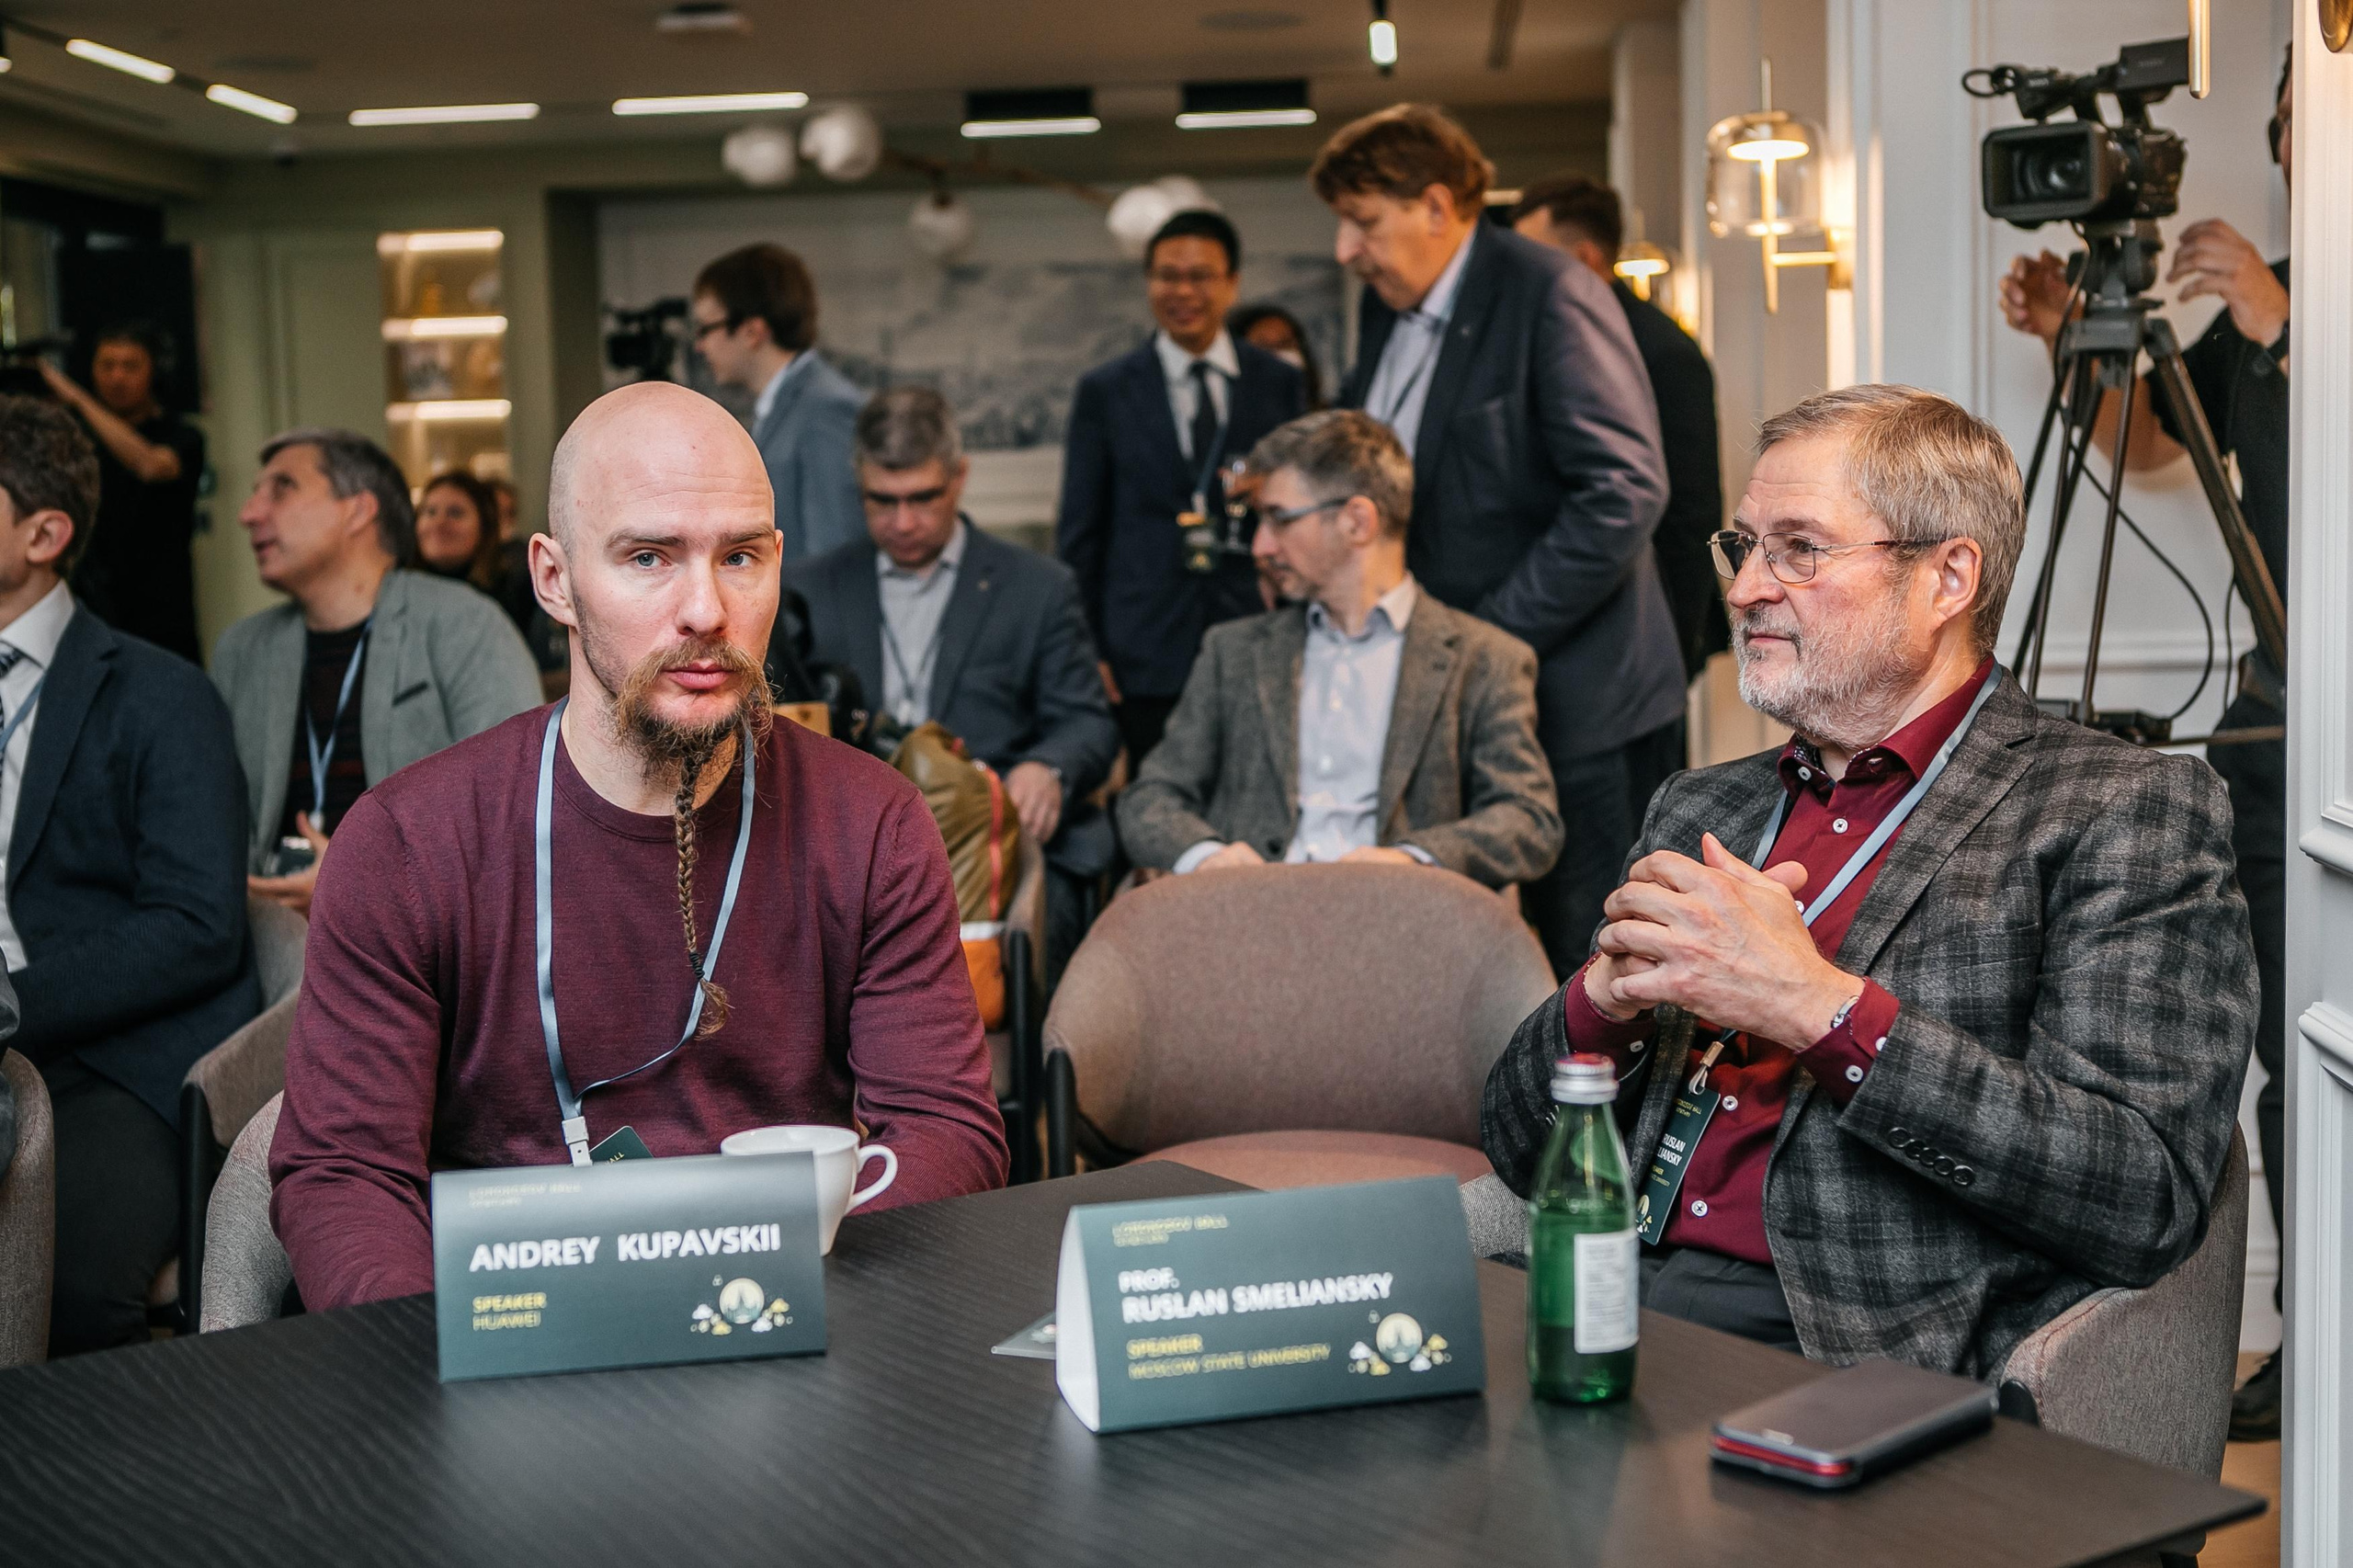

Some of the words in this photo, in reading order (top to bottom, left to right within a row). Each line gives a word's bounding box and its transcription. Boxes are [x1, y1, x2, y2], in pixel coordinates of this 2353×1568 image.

[1662, 1133, 1686, 1153] RUSLAN
[469, 1236, 601, 1272] ANDREY
[618, 1223, 781, 1262] KUPAVSKII
[1118, 1267, 1179, 1293] PROF.
[472, 1292, 547, 1313] SPEAKER
[1122, 1288, 1229, 1324] RUSLAN
[1232, 1272, 1393, 1313] SMELIANSKY
[472, 1310, 541, 1331] HUAWEI
